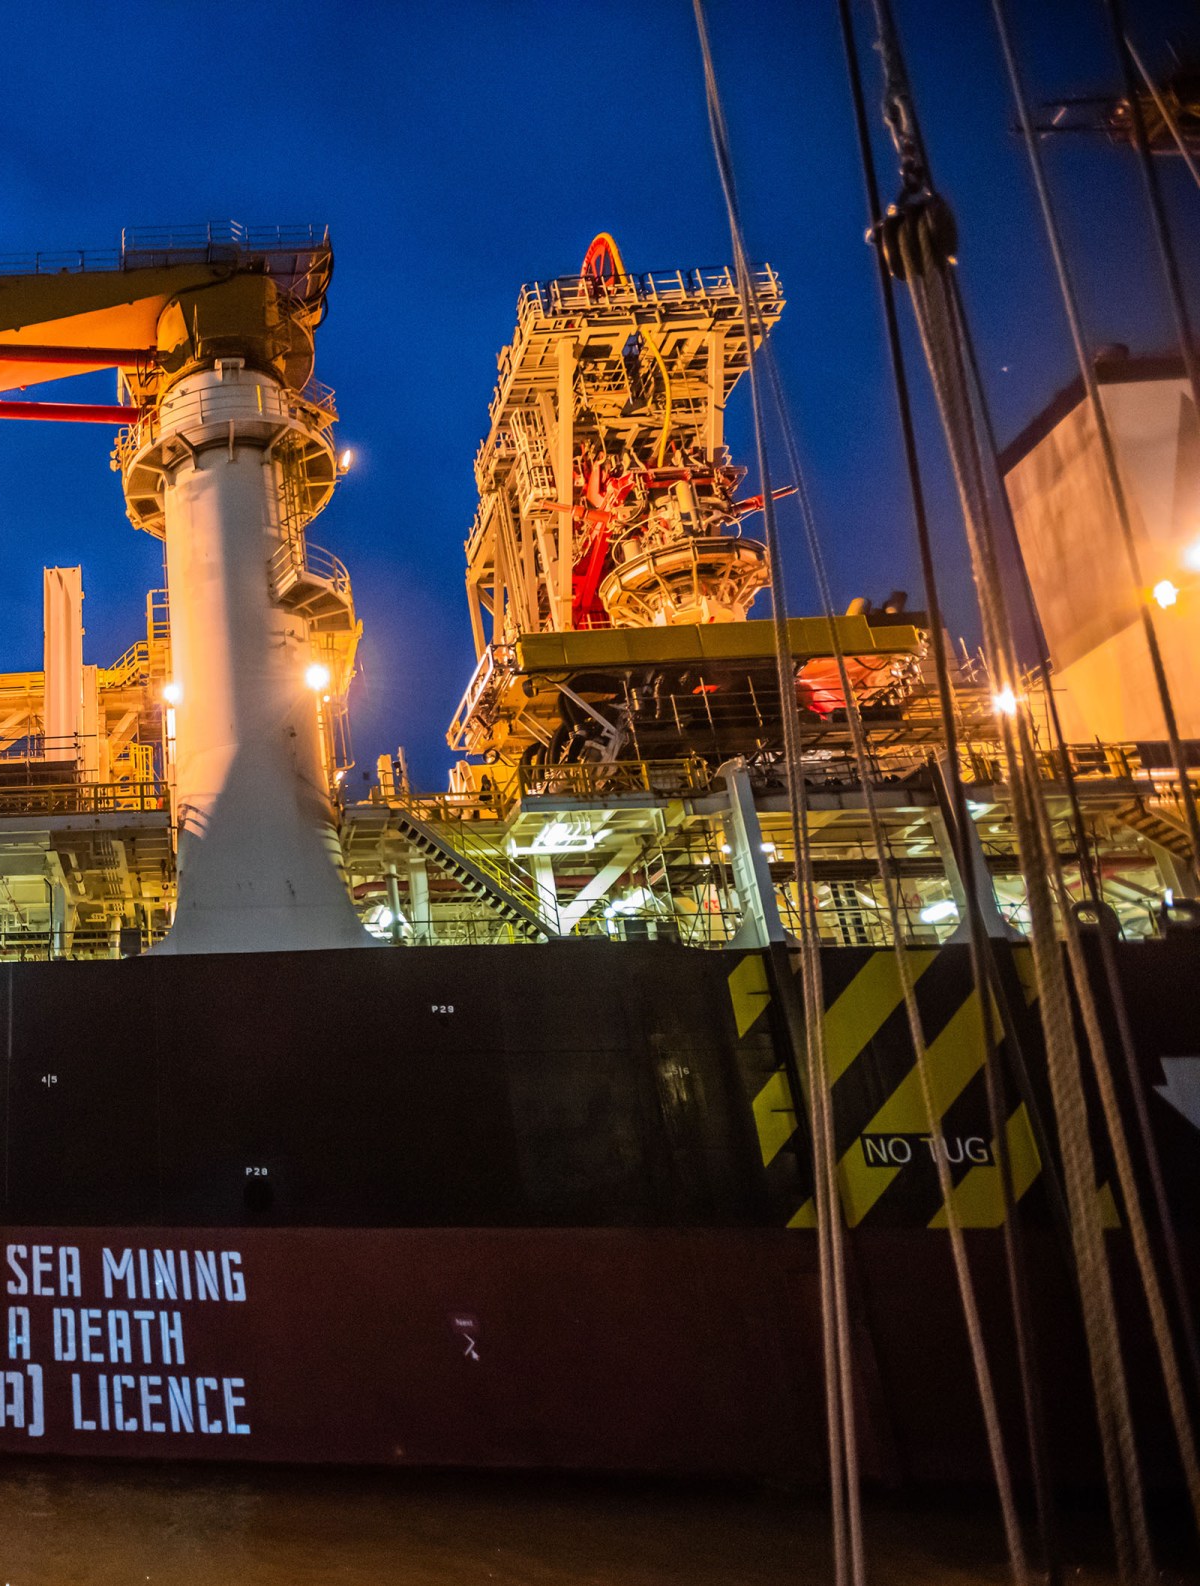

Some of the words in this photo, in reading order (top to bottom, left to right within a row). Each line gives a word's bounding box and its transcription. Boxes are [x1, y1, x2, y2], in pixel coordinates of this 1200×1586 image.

[865, 1137, 912, 1163] NO
[919, 1137, 989, 1163] TUG
[6, 1244, 81, 1297] SEA
[102, 1247, 247, 1302] MINING
[8, 1306, 31, 1360] A
[53, 1307, 186, 1365] DEATH
[71, 1373, 251, 1435] LICENCE
